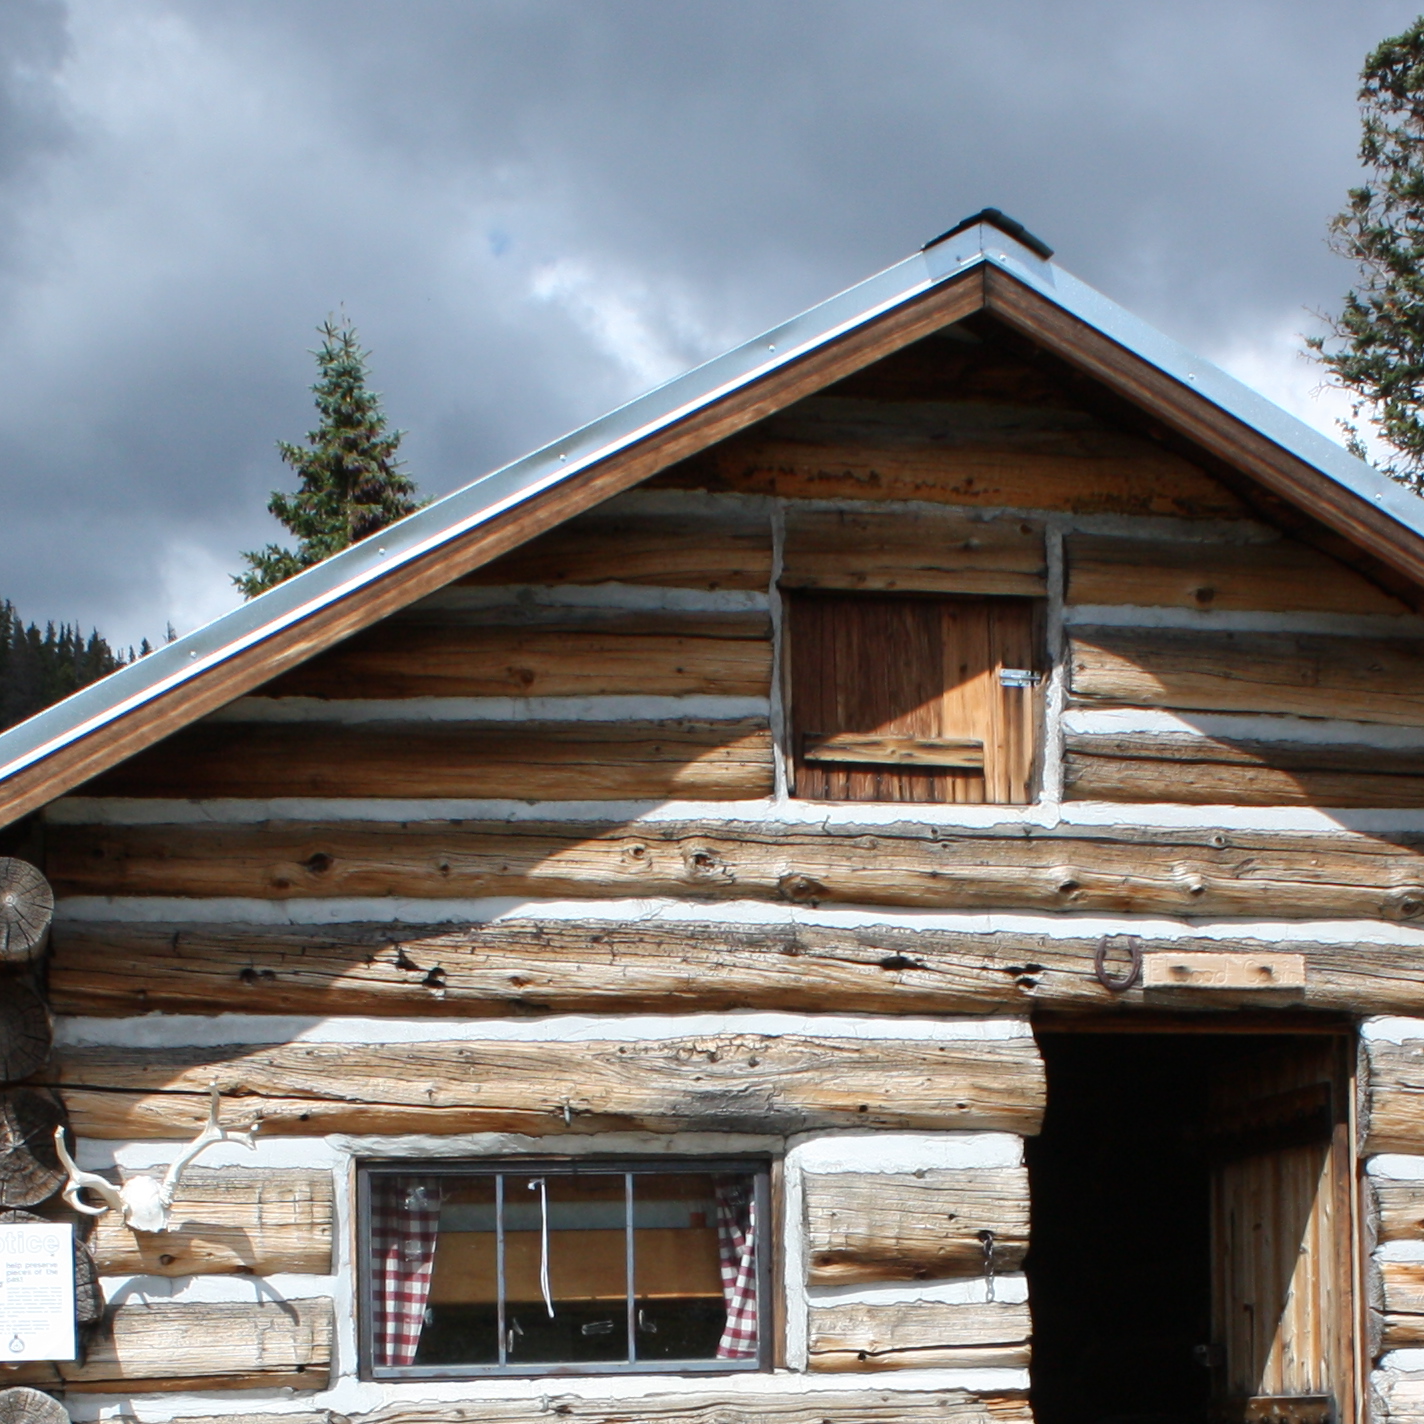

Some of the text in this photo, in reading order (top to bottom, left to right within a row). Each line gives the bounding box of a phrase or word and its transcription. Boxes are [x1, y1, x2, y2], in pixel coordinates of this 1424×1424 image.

[1243, 957, 1300, 985] Cabin
[6, 1262, 58, 1270] help preserve
[6, 1269, 32, 1277] pieces
[46, 1268, 58, 1276] the
